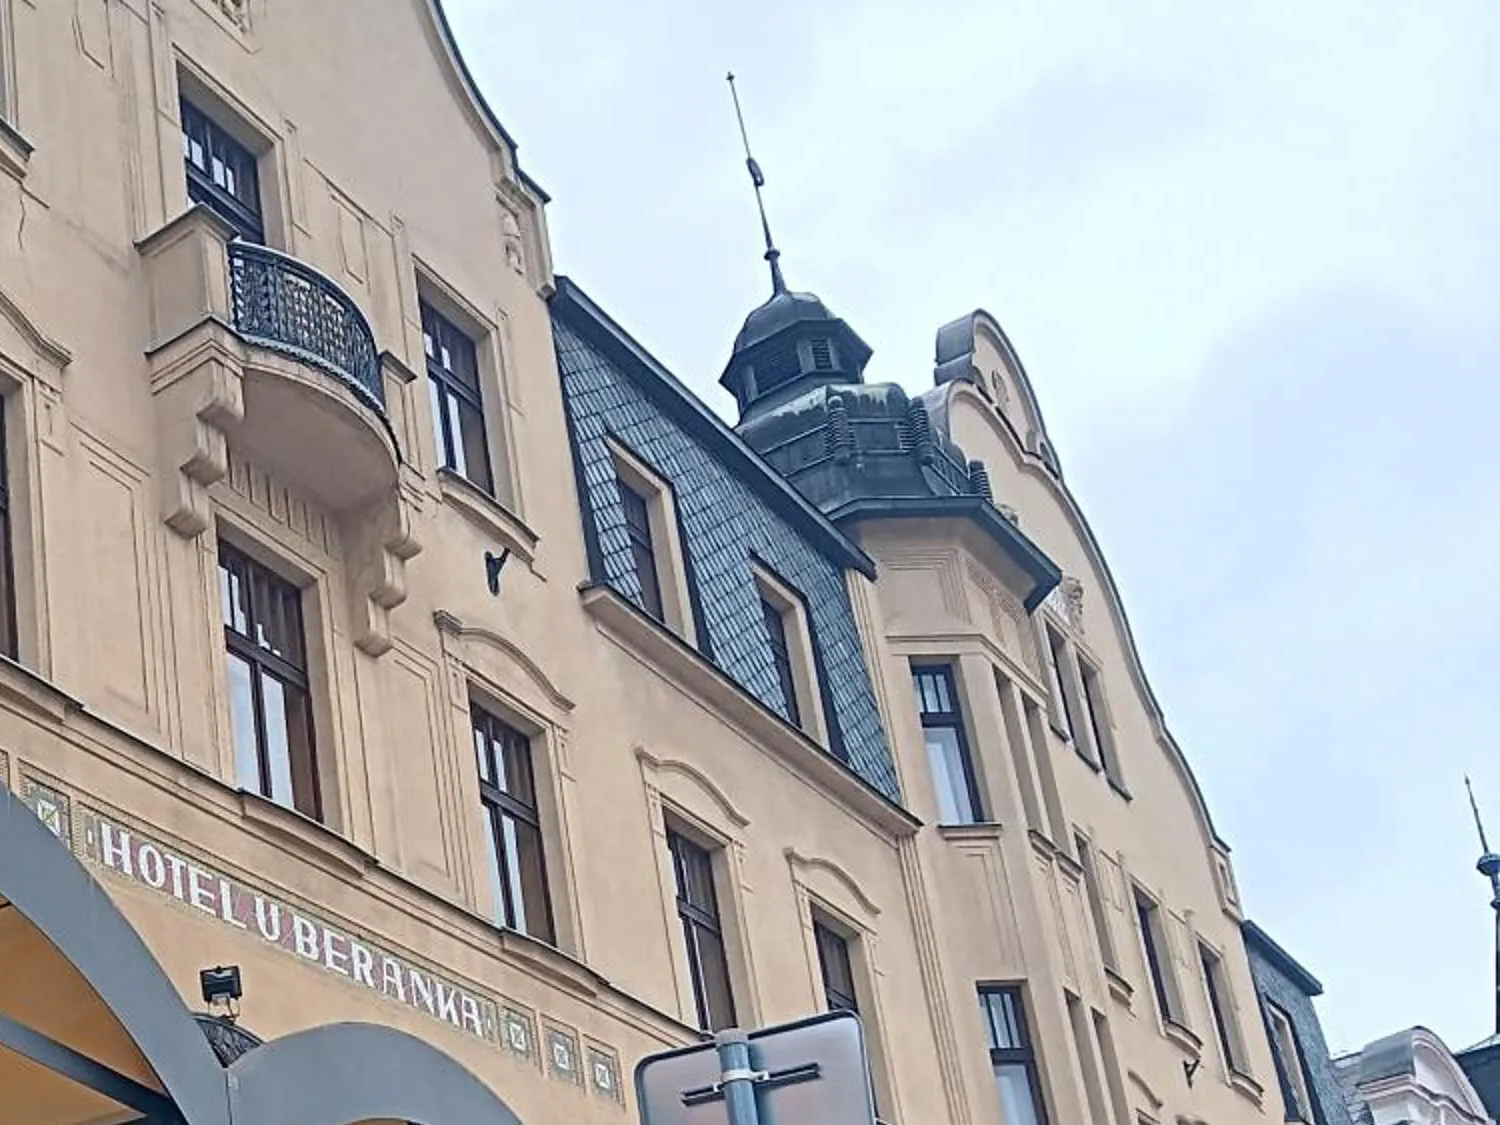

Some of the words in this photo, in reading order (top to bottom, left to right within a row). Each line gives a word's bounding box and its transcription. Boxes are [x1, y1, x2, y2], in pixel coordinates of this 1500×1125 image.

[101, 822, 247, 929] HOTEL
[255, 896, 280, 941] U
[293, 911, 483, 1037] BERANKA
